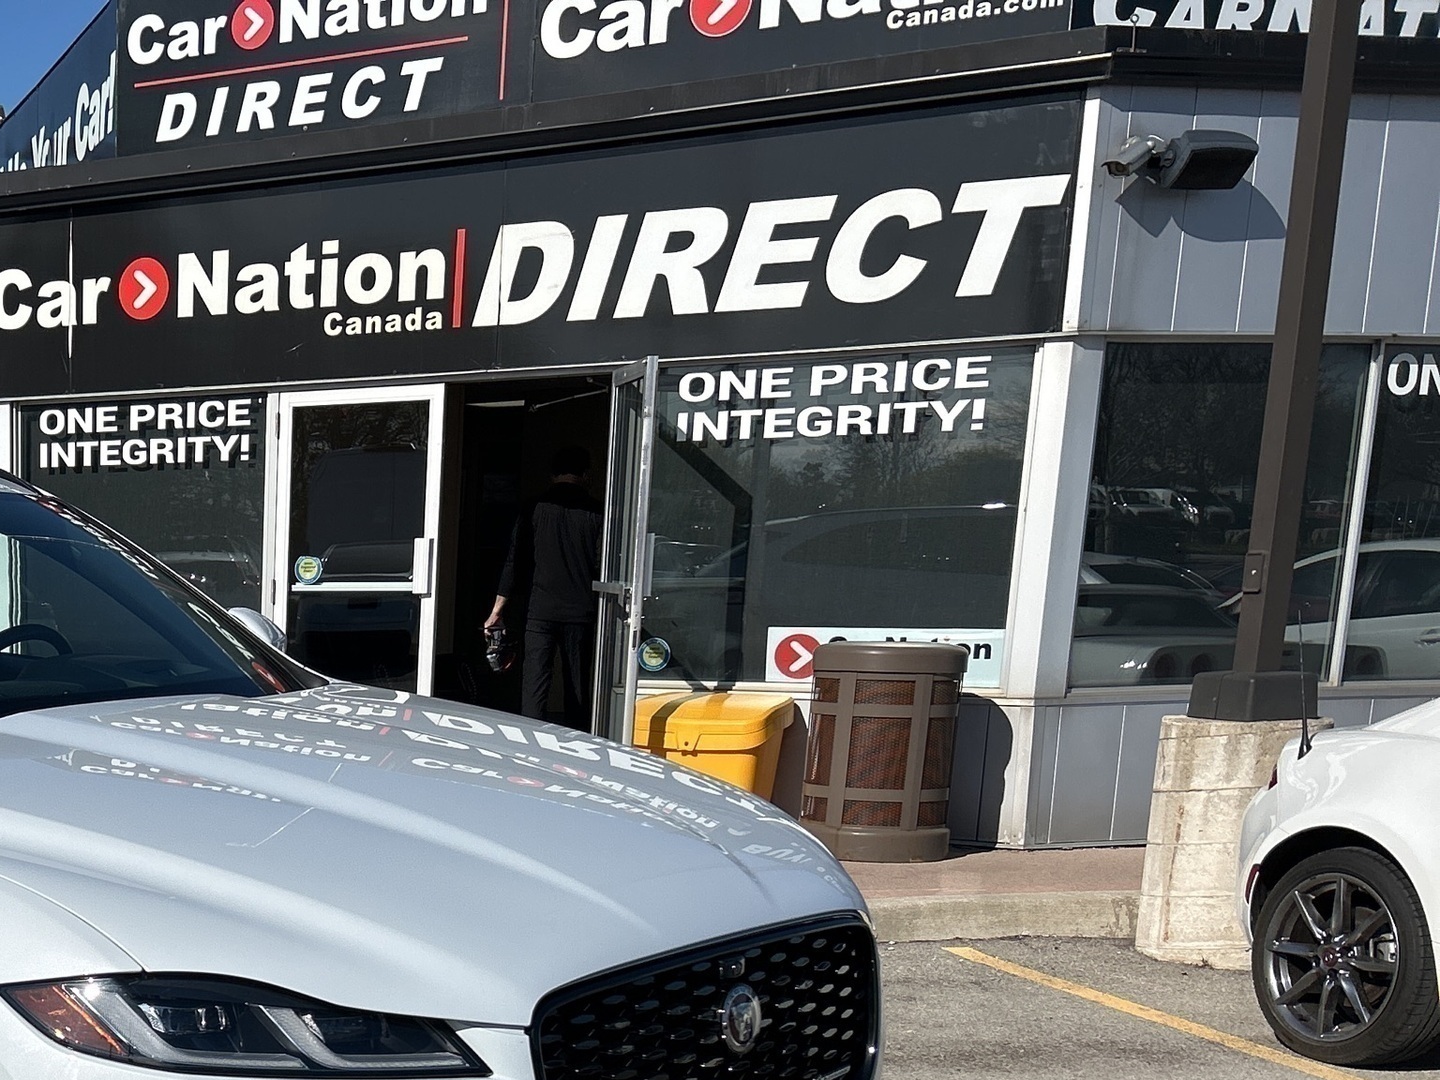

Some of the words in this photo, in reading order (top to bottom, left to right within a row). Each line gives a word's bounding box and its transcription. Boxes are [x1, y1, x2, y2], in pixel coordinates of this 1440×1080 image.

[127, 13, 226, 65] Car
[540, 0, 683, 59] Car
[75, 49, 117, 162] Car!
[155, 57, 444, 143] DIRECT
[177, 239, 446, 318] Nation
[471, 174, 1071, 328] DIRECT
[323, 307, 442, 337] Canada
[678, 367, 794, 403] ONE
[809, 355, 992, 397] PRICE
[39, 405, 119, 435] ONE
[129, 398, 252, 431] PRICE
[675, 398, 986, 442] INTEGRITY!
[39, 434, 250, 469] INTEGRITY!
